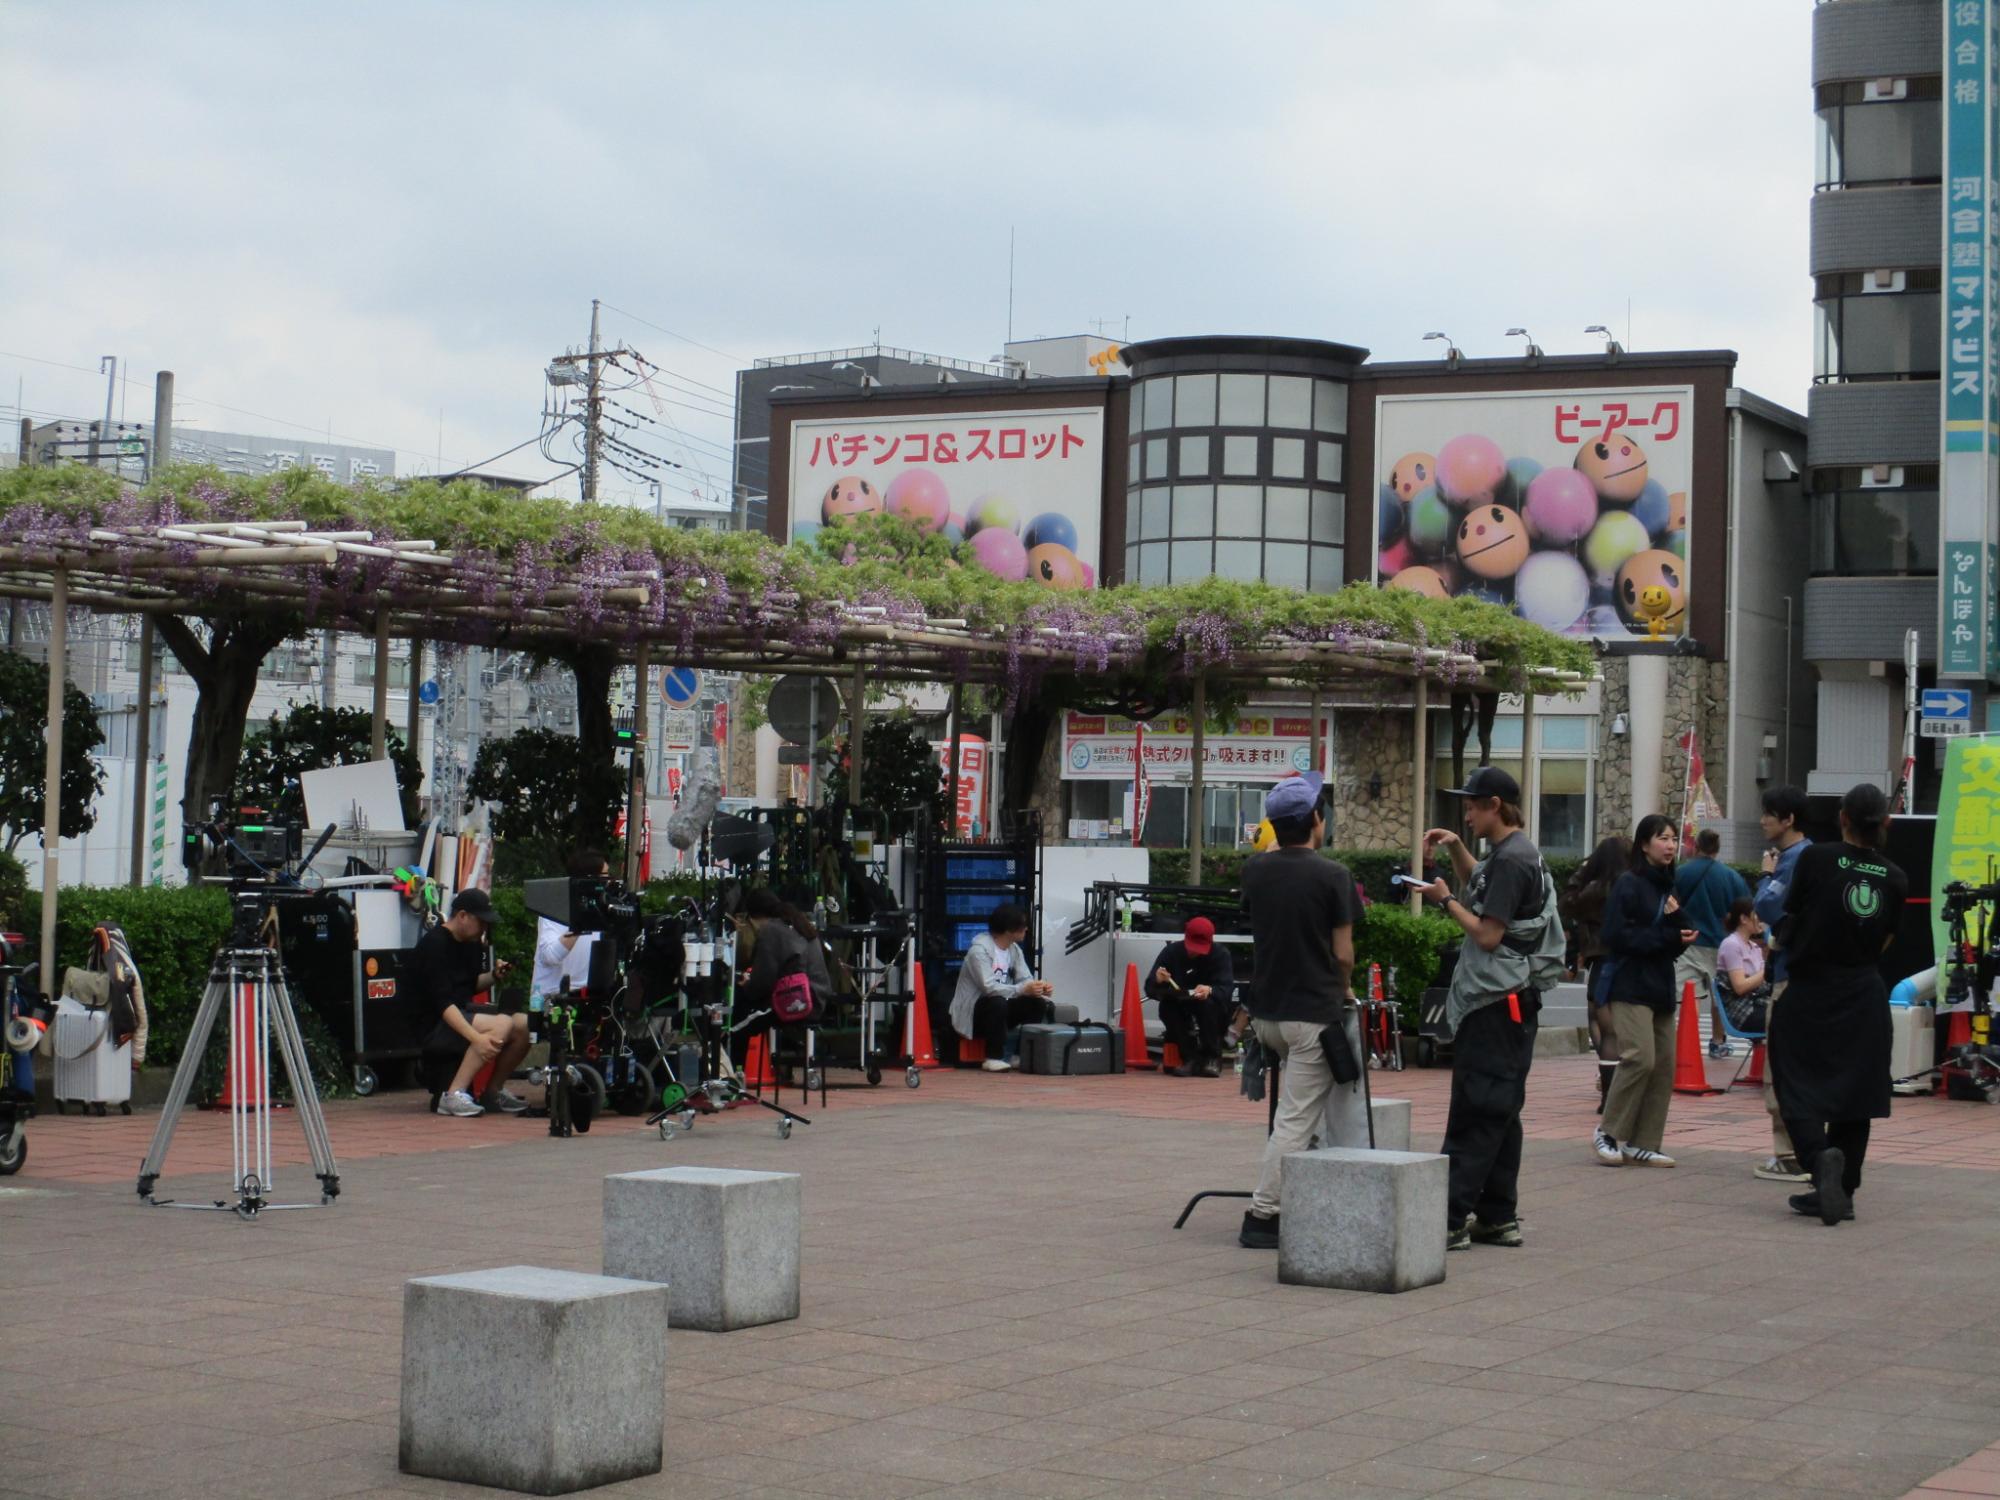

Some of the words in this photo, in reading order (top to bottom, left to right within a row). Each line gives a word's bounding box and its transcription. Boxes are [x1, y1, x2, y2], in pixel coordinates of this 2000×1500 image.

[1951, 176, 1982, 396] 河合塾マナビス
[809, 424, 1084, 467] パチンコ&スロット
[1554, 401, 1680, 444] ピーアーク
[1951, 550, 1975, 645] なんぼや
